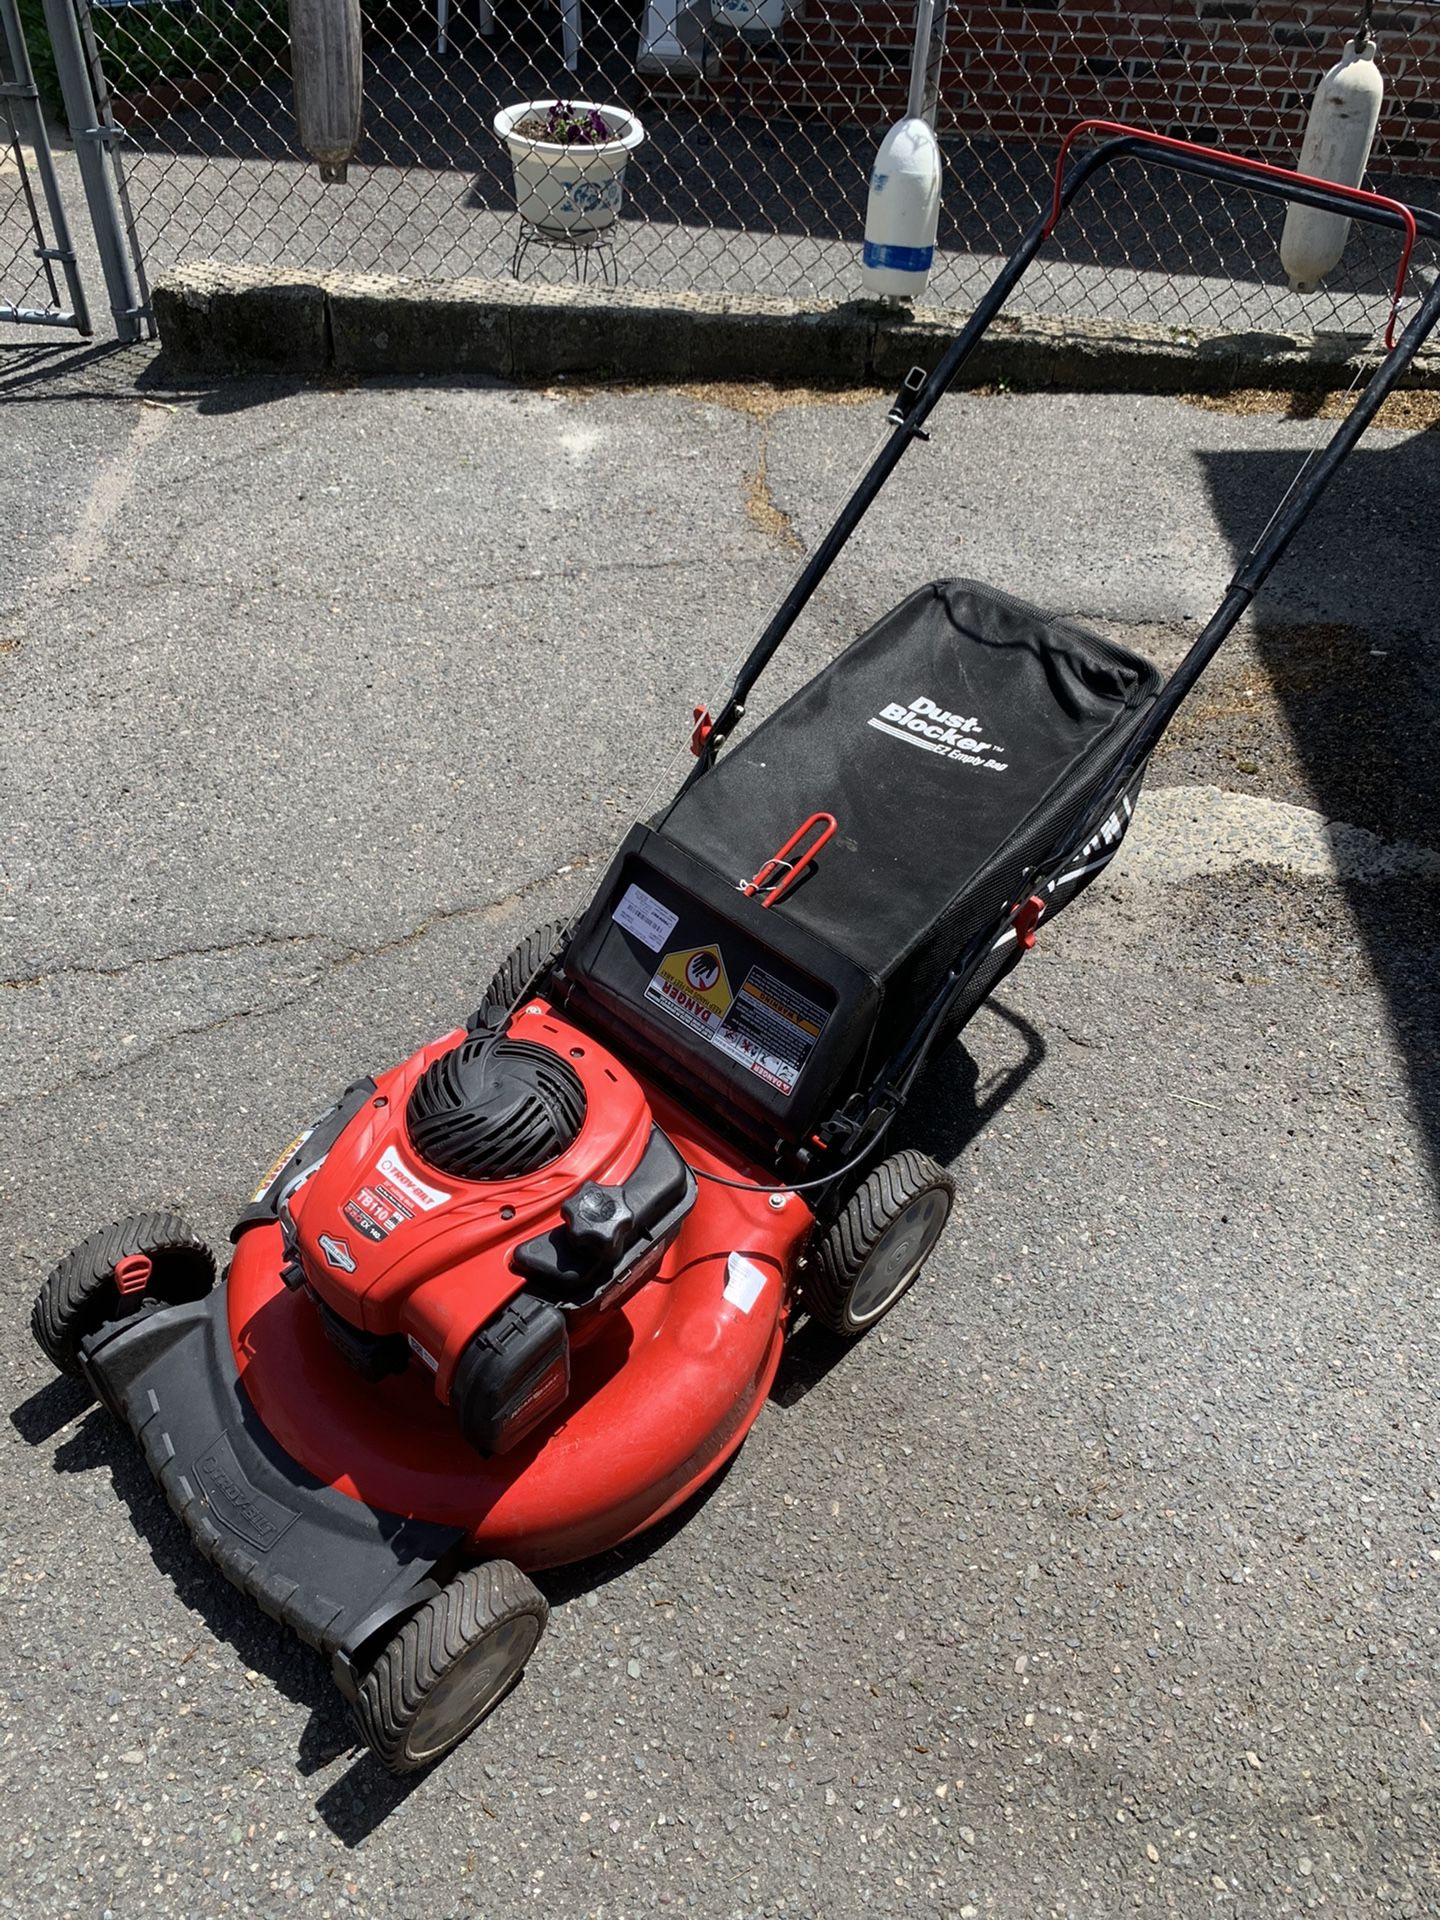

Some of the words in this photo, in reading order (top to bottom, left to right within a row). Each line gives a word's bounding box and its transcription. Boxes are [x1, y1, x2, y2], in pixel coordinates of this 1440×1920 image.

[879, 702, 992, 752] Blocker
[908, 696, 982, 732] Dust-
[933, 743, 952, 756] EZ
[948, 749, 985, 766] Empty
[983, 759, 1009, 772] Bag
[662, 981, 712, 1022] DANGER
[760, 993, 795, 1019] WARNING
[753, 1065, 783, 1088] DANGER
[390, 1167, 435, 1205] TROY-BILT
[357, 1189, 389, 1221] TB110
[360, 1219, 374, 1230] EX
